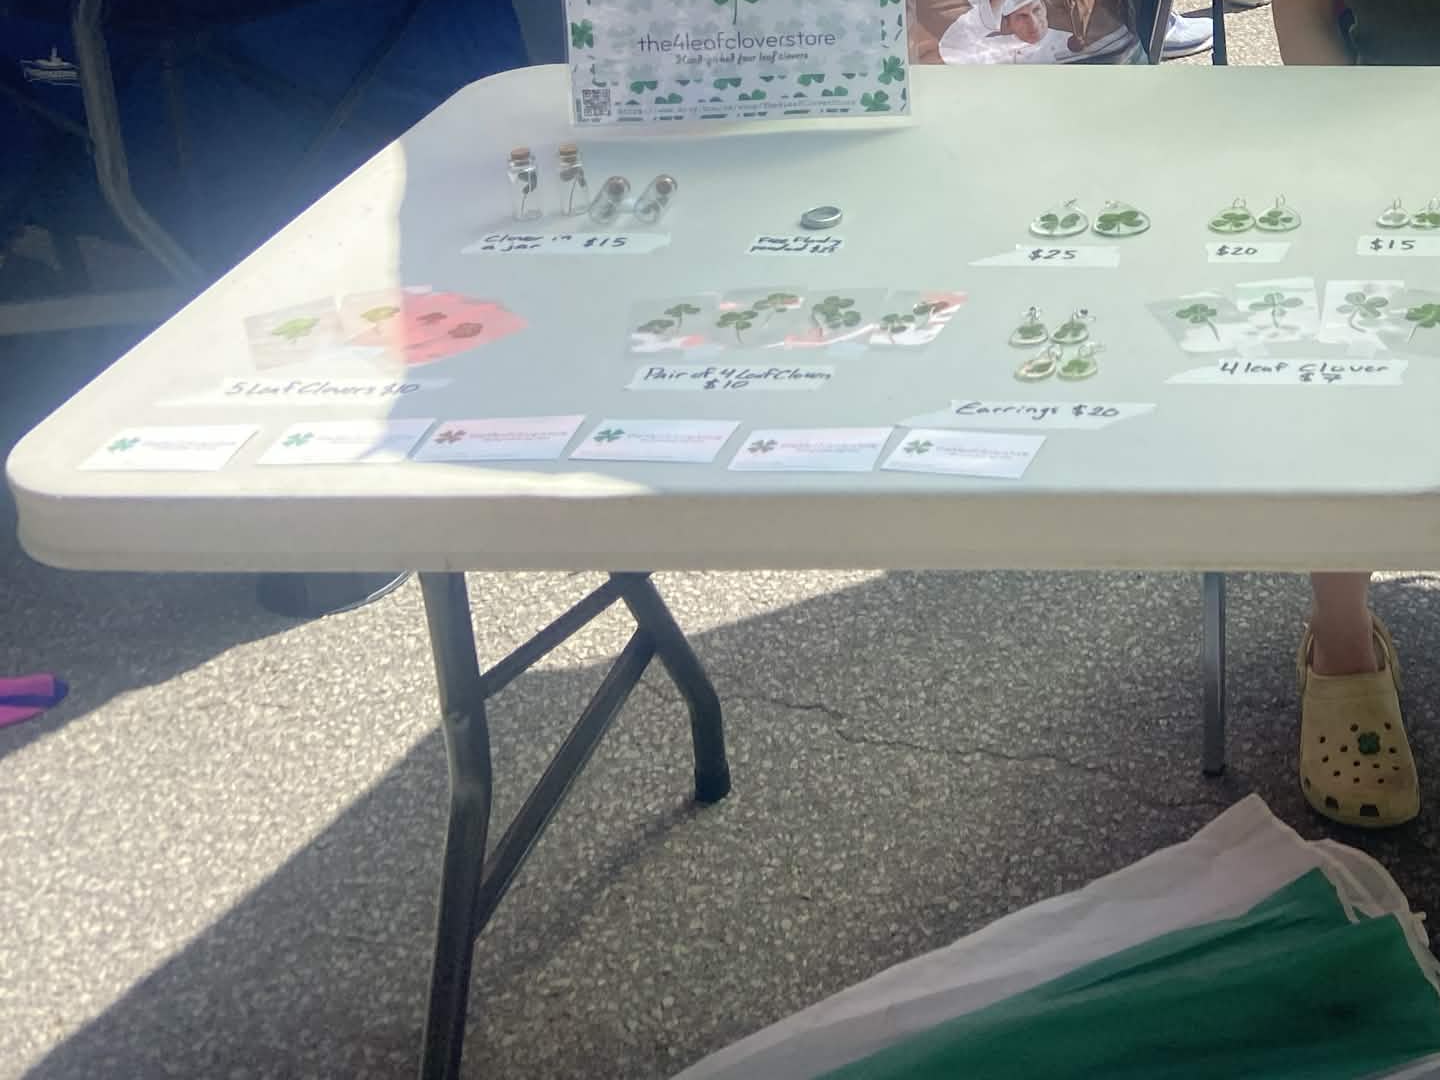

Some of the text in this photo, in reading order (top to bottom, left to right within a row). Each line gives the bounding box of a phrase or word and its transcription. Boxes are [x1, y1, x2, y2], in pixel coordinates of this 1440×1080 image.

[637, 30, 836, 53] the4leafcloverstore
[583, 236, 628, 248] $15
[1369, 237, 1416, 251] $15
[1028, 248, 1079, 262] $25
[1214, 244, 1260, 257] $20
[644, 367, 689, 381] Pair
[1220, 361, 1240, 375] 4
[225, 380, 247, 396] 5
[955, 402, 1121, 420] Earrings $20
